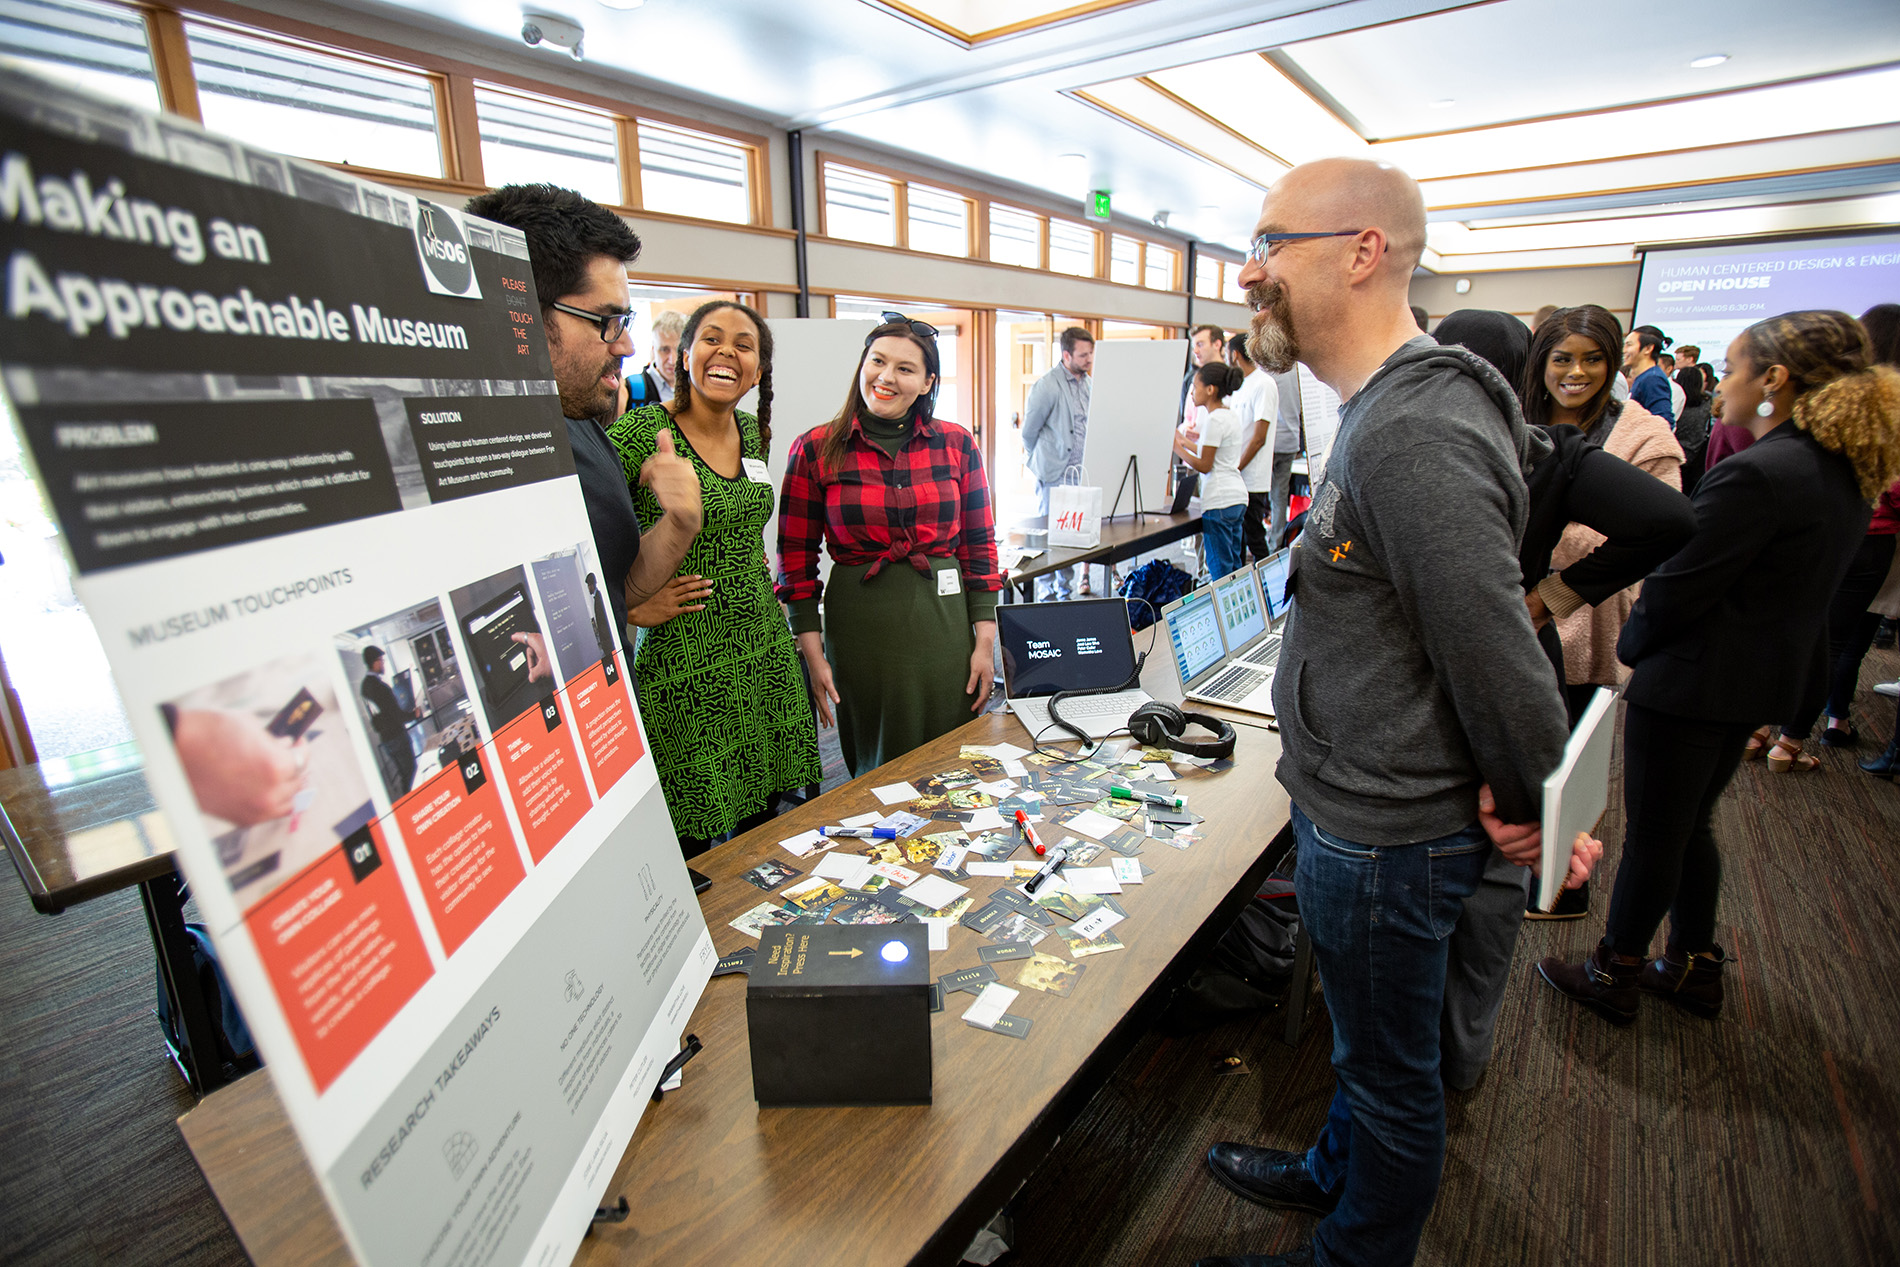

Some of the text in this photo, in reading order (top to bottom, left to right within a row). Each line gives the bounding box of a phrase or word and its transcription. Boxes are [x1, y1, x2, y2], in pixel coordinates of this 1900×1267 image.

[0, 152, 271, 264] Making an
[422, 236, 467, 264] MS06
[1660, 265, 1710, 278] HUMAN
[1712, 260, 1785, 275] CENTERED
[1787, 257, 1843, 271] DESIGN
[1845, 256, 1857, 268] &
[502, 277, 528, 293] PLEASE
[1657, 275, 1772, 293] OPEN HOUSE
[8, 251, 470, 351] Approachable Museum
[1691, 304, 1728, 313] AWARDS
[509, 310, 534, 325] TOUCH
[513, 327, 528, 340] THE
[517, 344, 530, 356] ART
[420, 411, 462, 425] SOLUTION
[428, 442, 446, 452] Using
[445, 440, 461, 449] visitor
[461, 438, 473, 447] and
[472, 437, 489, 446] human
[489, 435, 509, 444] centered
[532, 430, 552, 441] developed
[288, 452, 337, 467] relationship
[336, 450, 353, 462] with
[433, 457, 465, 469] touchpoints
[465, 456, 476, 464] that
[475, 454, 489, 464] open
[510, 449, 529, 458] dialogue
[528, 446, 547, 456] between
[237, 483, 276, 500] barriers
[274, 478, 301, 493] which
[300, 475, 326, 489] make
[331, 471, 360, 485] difficult
[358, 469, 371, 481] for
[447, 474, 471, 484] Museum
[470, 472, 481, 481] and
[480, 470, 489, 479] the
[126, 568, 354, 650] MUSEUM TOUCHPOINTS
[1026, 640, 1050, 650] Team
[1028, 648, 1062, 660] MOSAIC
[606, 663, 614, 675] 04
[576, 681, 598, 700] COMMUNITY
[545, 705, 556, 719] 03
[579, 697, 590, 708] VOICE
[555, 747, 560, 755] to
[465, 762, 479, 779] 02
[541, 767, 552, 780] voice
[552, 762, 557, 770] to
[556, 756, 564, 766] the
[411, 789, 451, 823] SHARE YOUR
[415, 795, 461, 835] OWN CREATION
[426, 812, 483, 864] Each collage creator
[430, 819, 492, 876] has the option to hang
[435, 872, 449, 888] their
[449, 851, 472, 875] creation
[440, 846, 495, 901] visitor display for the
[444, 880, 475, 915] community
[475, 874, 481, 883] to
[768, 945, 782, 965] Need
[777, 932, 795, 976] Inspiration?
[792, 934, 810, 975] Press Here
[956, 972, 980, 982] circle
[560, 982, 604, 1053] NO ONE TECHNOLOGY
[360, 1005, 501, 1191] RESEARCH TAKEAWAYS
[471, 1163, 488, 1190] OWN
[488, 1110, 522, 1167] ADVENTURE
